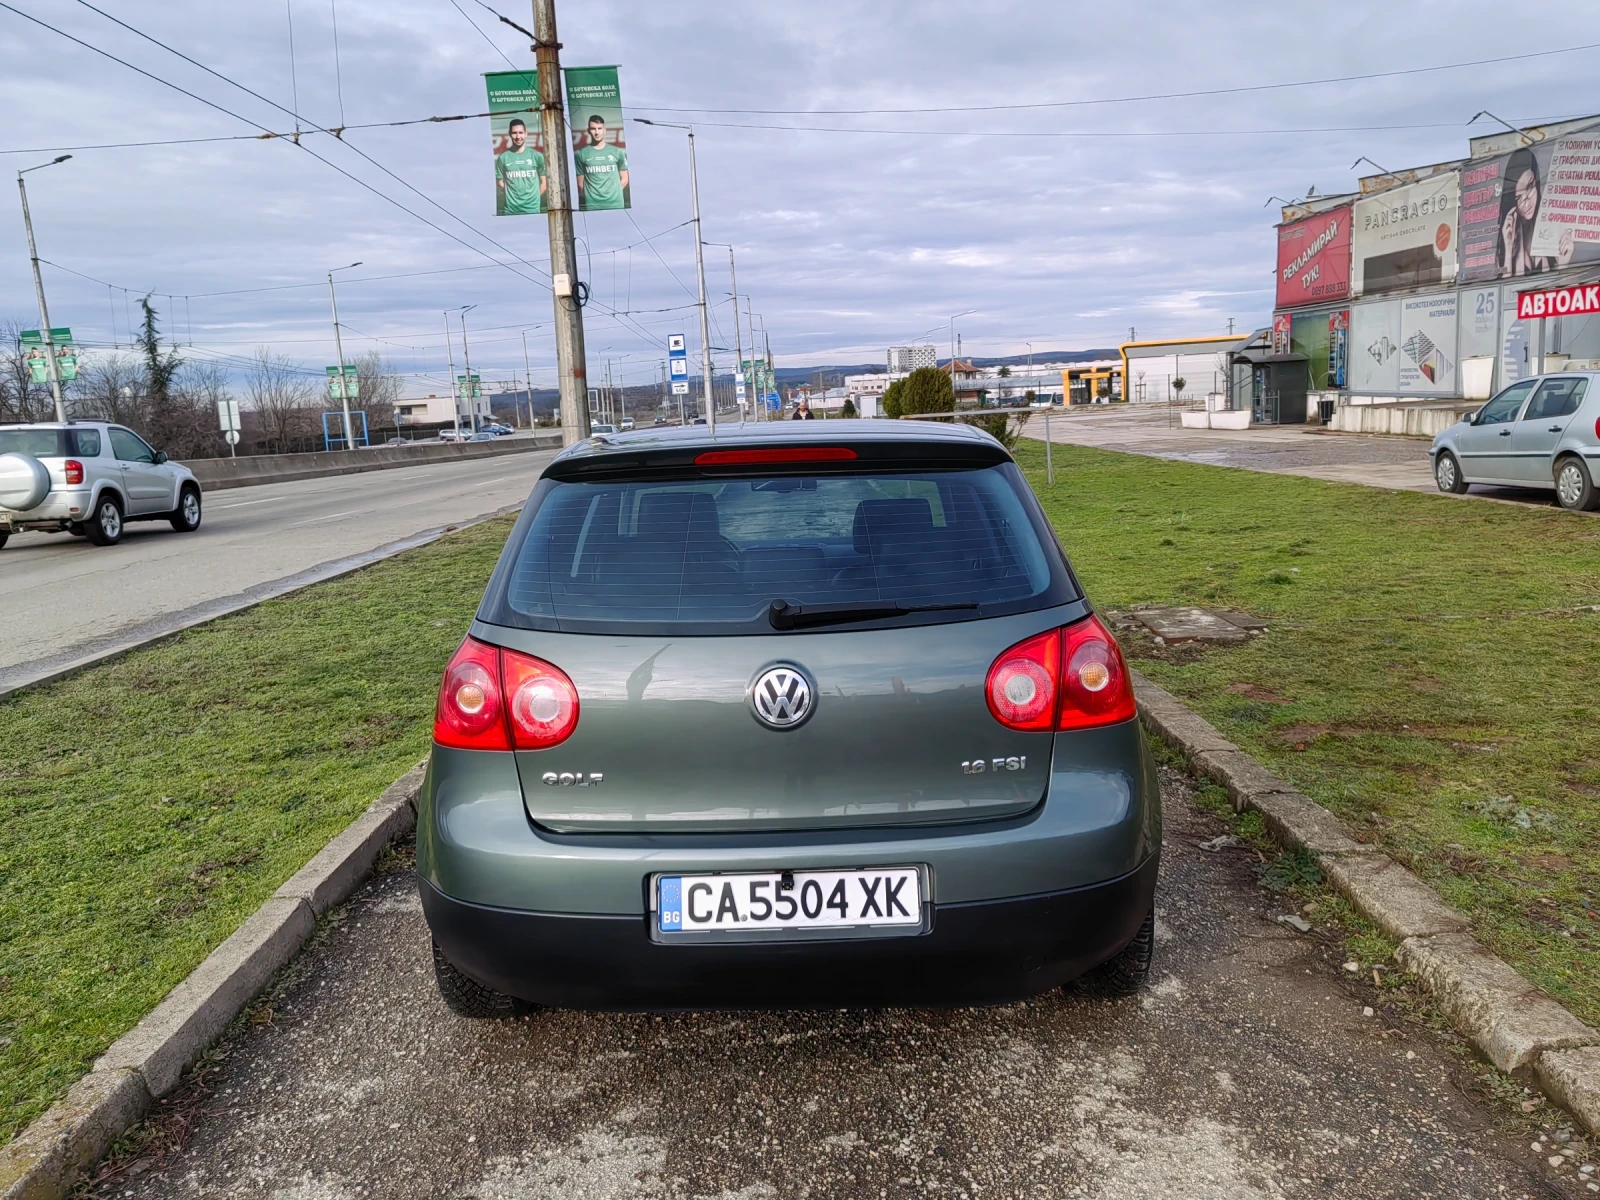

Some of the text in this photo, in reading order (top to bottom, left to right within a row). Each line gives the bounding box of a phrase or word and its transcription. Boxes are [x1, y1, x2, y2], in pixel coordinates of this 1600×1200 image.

[1559, 155, 1590, 165] ГРАФИЧЕН
[506, 170, 536, 178] WINBET
[586, 165, 616, 173] WINBET
[1558, 171, 1583, 180] ПЕЧАТНА
[1554, 185, 1579, 195] ВЪНШНА
[1548, 199, 1578, 209] РЕКЛАМНИ
[1364, 194, 1448, 231] PANCRACIO
[1548, 213, 1577, 223] ФИРМЕНИ
[1399, 225, 1426, 236] CHOCOLATE
[1283, 219, 1338, 283] РЕКЛАМИРАЙ
[1301, 264, 1320, 289] ТУК!
[1336, 281, 1346, 292] 333
[1405, 298, 1456, 310] ВИСОКОТЕХНОЛОГИЧНИ
[1476, 291, 1495, 315] 25
[1520, 286, 1600, 316] АВТОАК
[1429, 309, 1456, 318] МАТЕРИАЛИ
[992, 756, 1027, 772] FSI
[542, 772, 604, 787] GOLF
[749, 878, 849, 921] 5504
[858, 876, 911, 919] XK
[663, 910, 681, 924] BG
